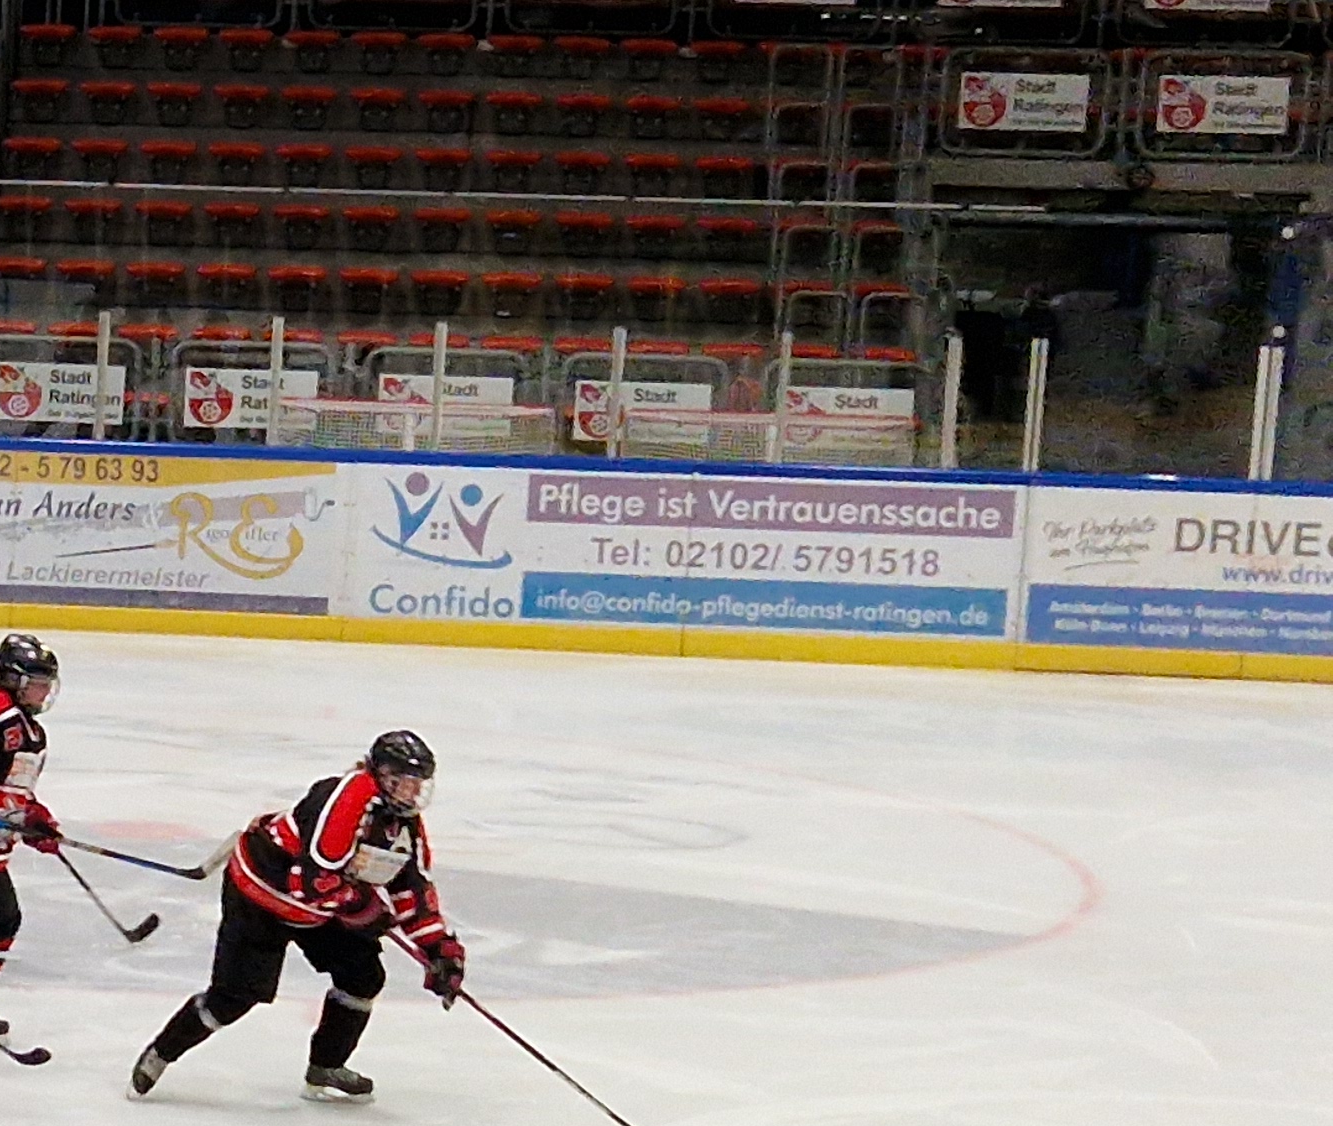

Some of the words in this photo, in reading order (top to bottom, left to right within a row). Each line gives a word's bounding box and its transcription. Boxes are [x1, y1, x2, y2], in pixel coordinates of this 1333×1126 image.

[49, 370, 92, 385] Stadt
[241, 375, 284, 390] Stat
[37, 456, 50, 479] 5
[59, 457, 87, 480] 79
[95, 458, 122, 481] 63
[130, 458, 159, 482] 93
[32, 491, 138, 521] Anders
[538, 483, 646, 524] Pflege
[658, 488, 697, 519] ist
[708, 488, 1002, 529] Vertrauenssache
[590, 537, 650, 566] Tel:
[793, 545, 939, 577] 5791518
[6, 561, 210, 589] Lackierermeister
[369, 584, 515, 618] Confido
[536, 588, 989, 628] info@confido-pflegedienst-ratingen.de
